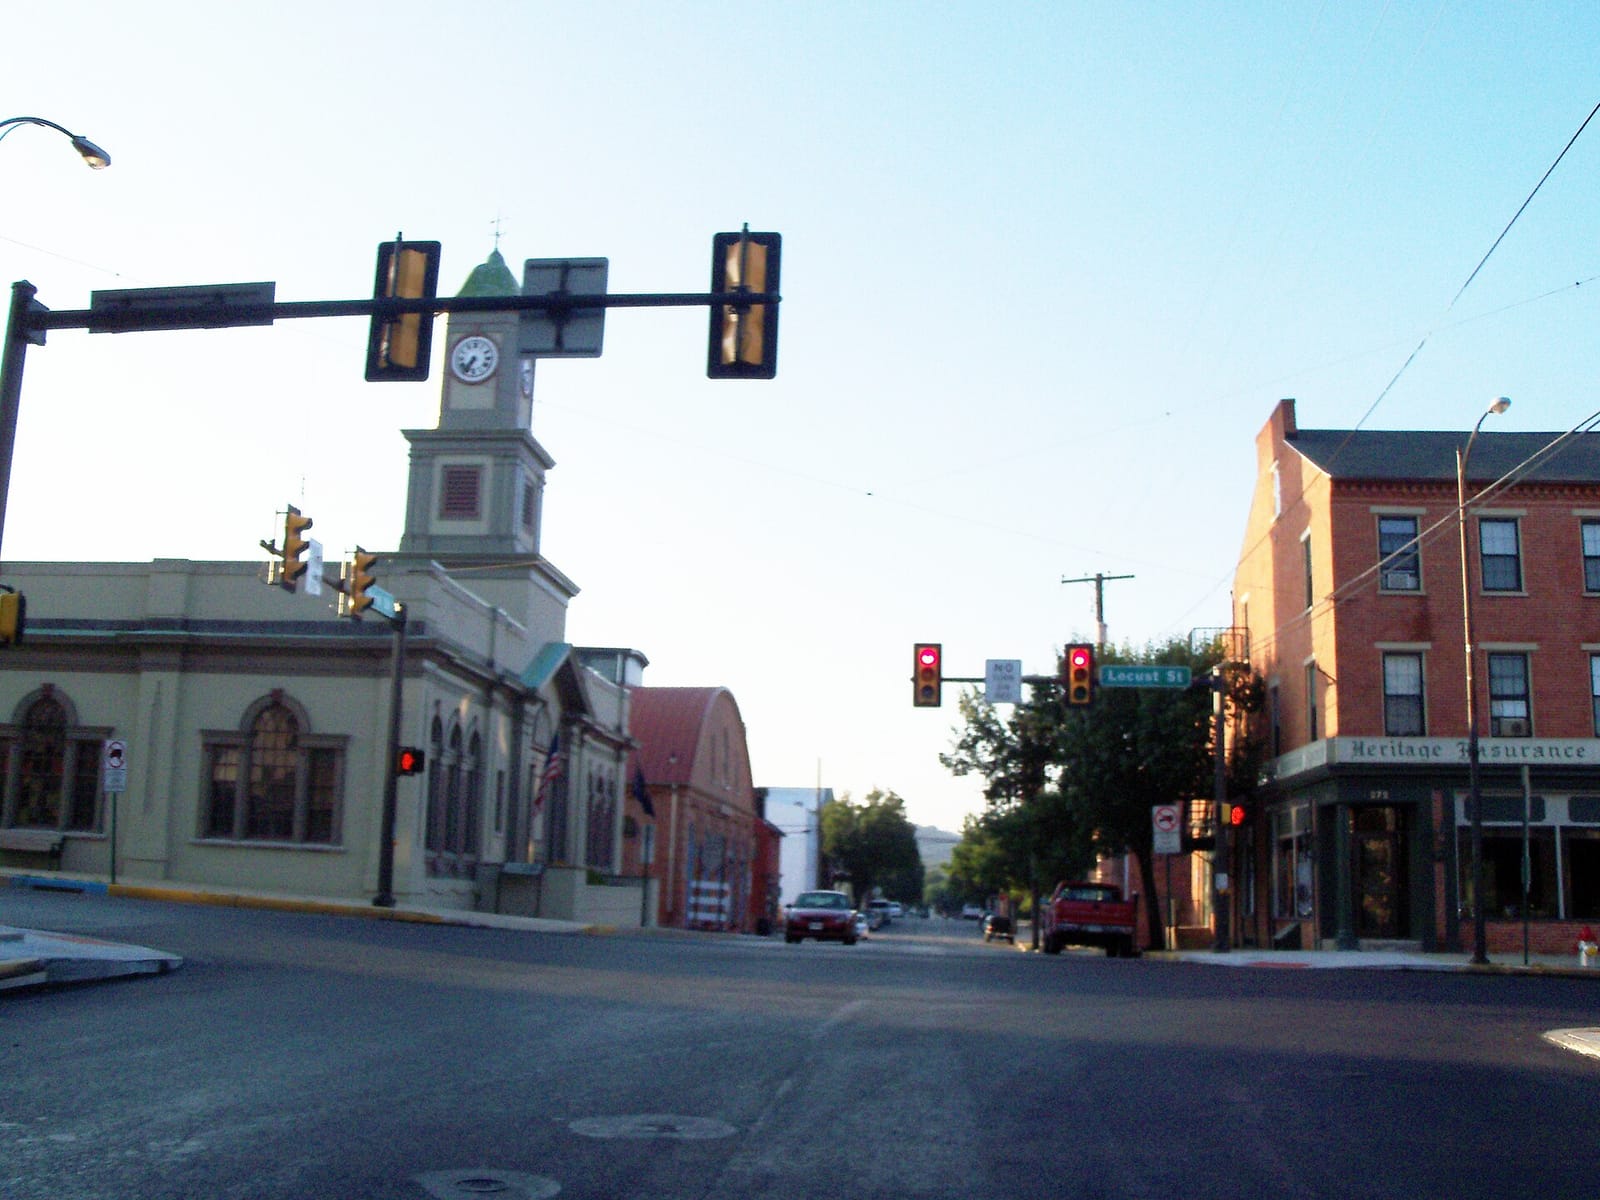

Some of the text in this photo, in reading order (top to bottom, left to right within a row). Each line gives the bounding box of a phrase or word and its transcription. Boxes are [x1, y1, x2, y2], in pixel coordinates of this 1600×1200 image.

[1108, 670, 1183, 682] Locust St
[1352, 740, 1586, 761] Heritage Insurance
